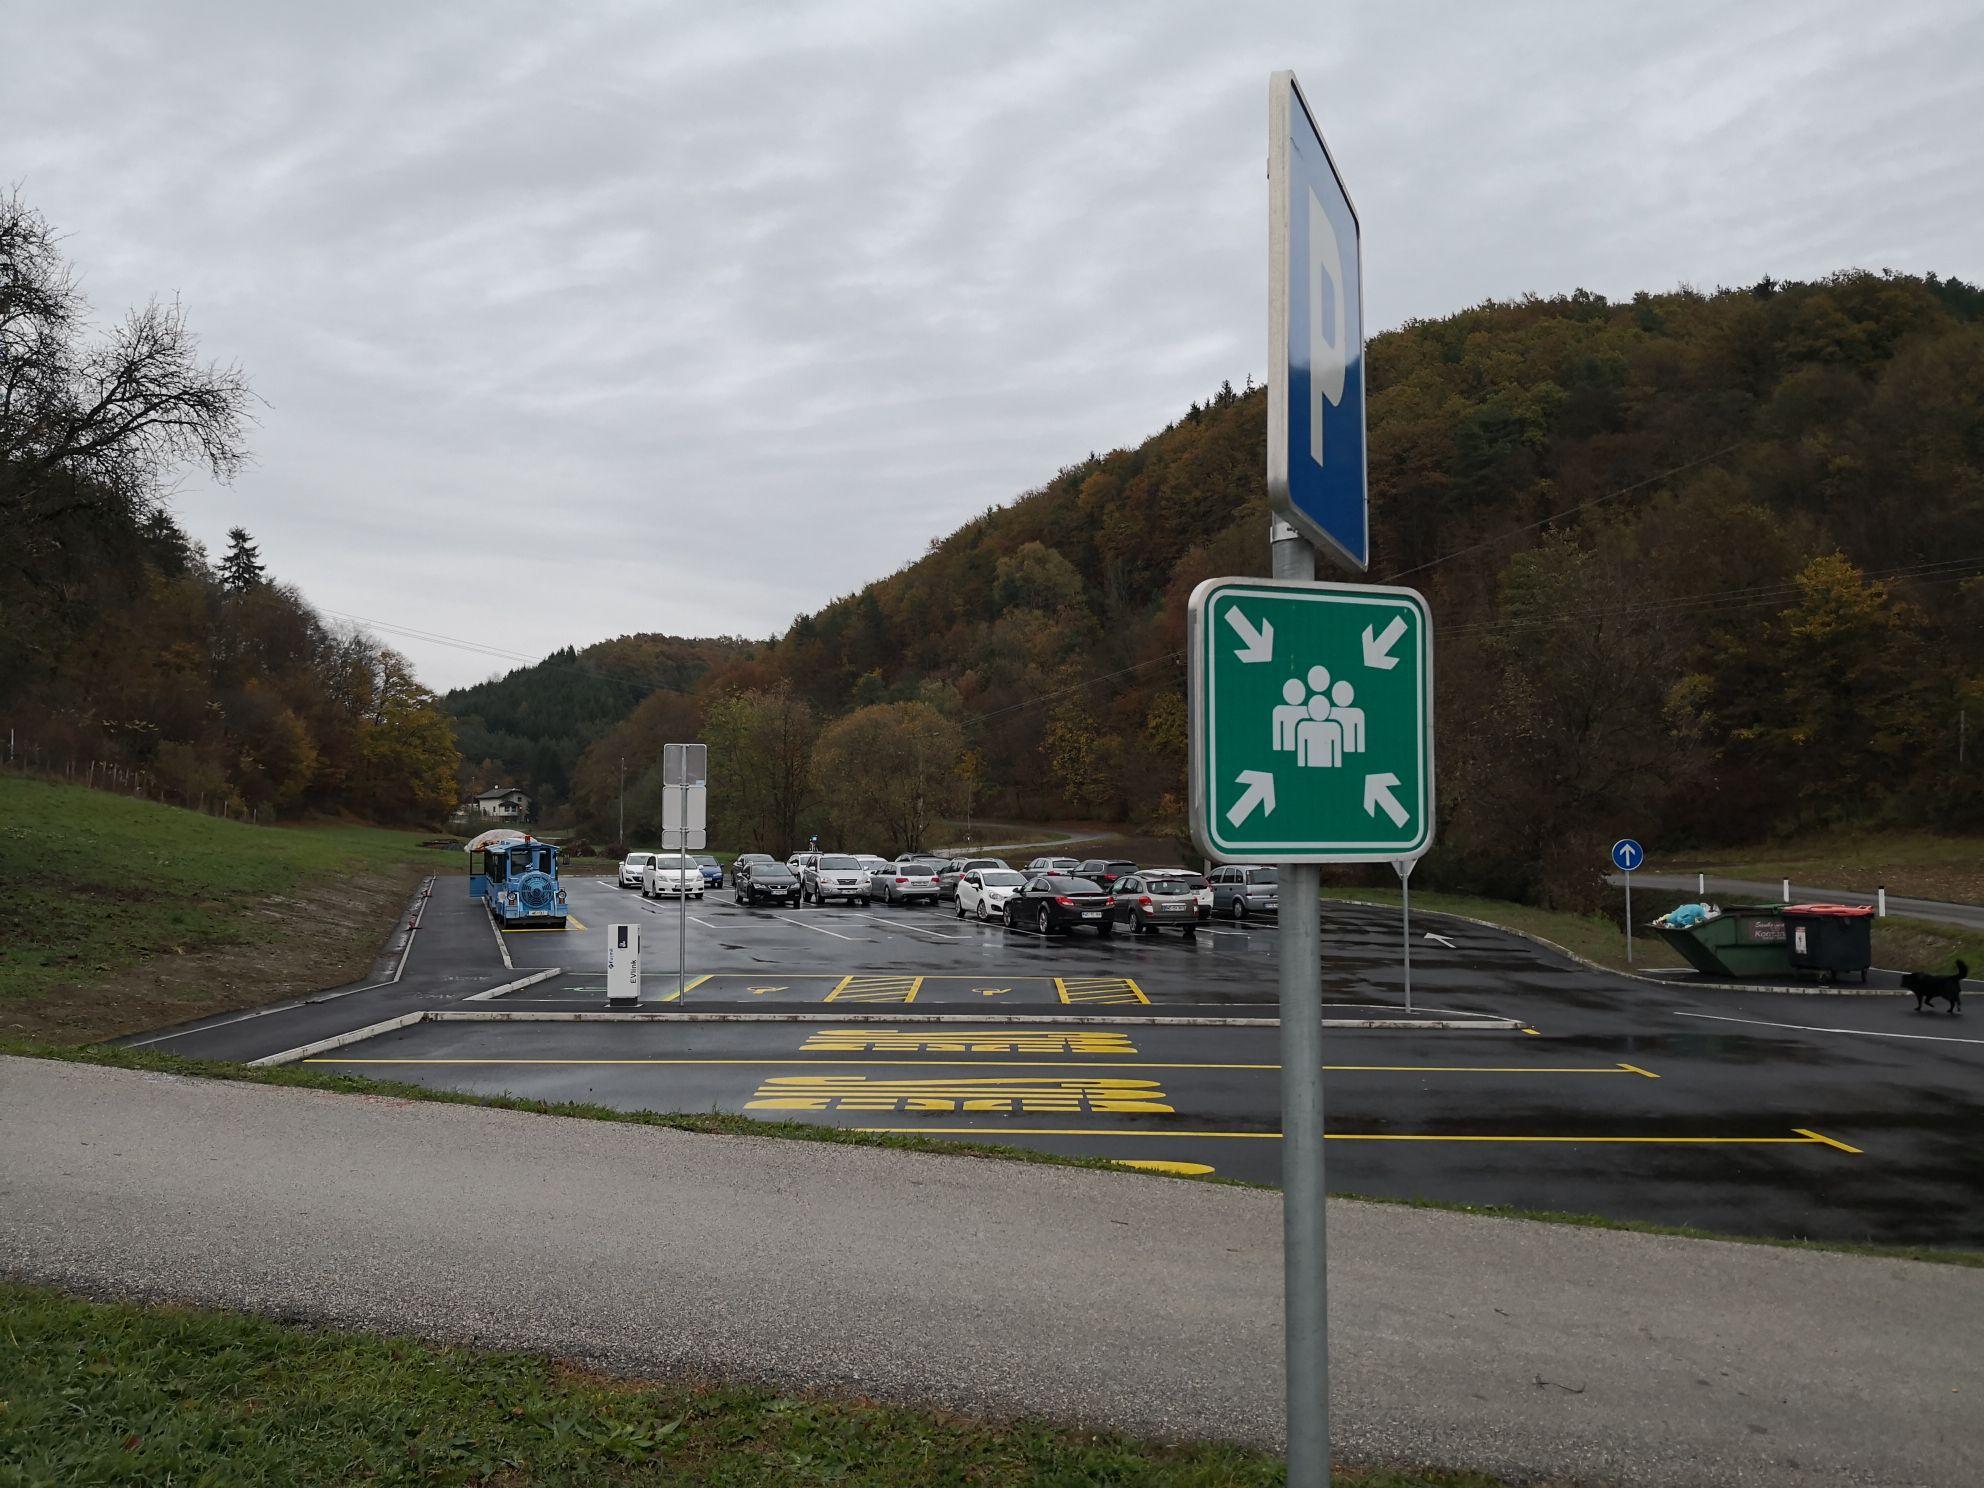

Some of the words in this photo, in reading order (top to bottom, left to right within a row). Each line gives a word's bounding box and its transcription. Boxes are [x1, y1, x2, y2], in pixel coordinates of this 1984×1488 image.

[1309, 185, 1346, 467] P
[798, 1029, 1138, 1053] BUS
[744, 1075, 1175, 1113] BUS
